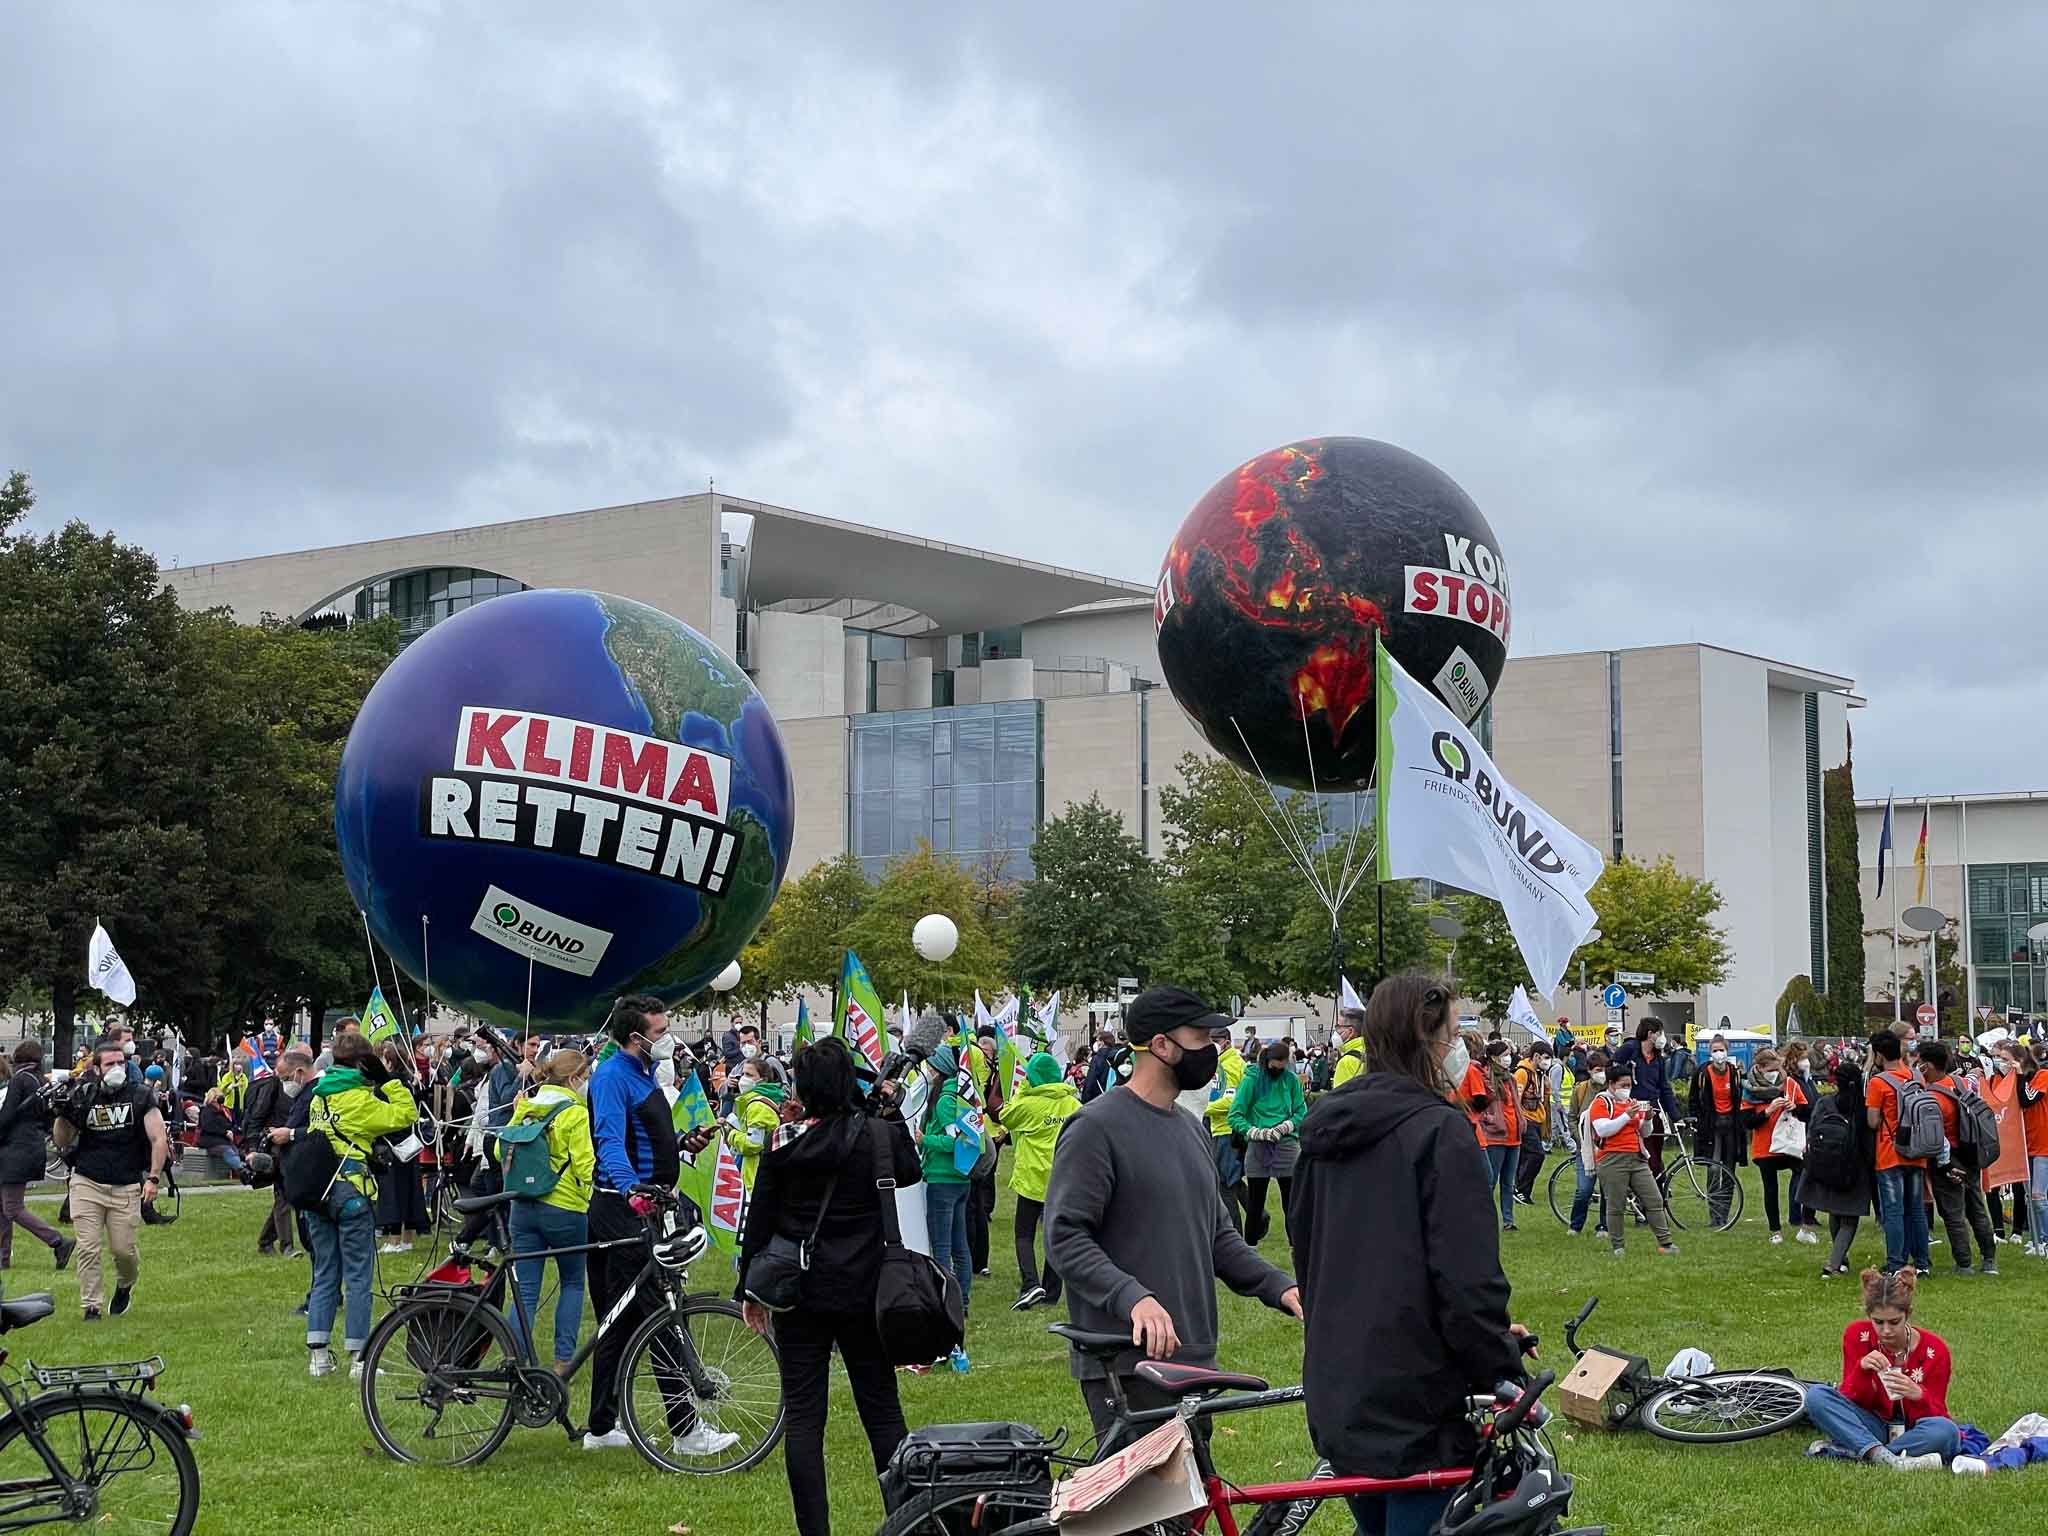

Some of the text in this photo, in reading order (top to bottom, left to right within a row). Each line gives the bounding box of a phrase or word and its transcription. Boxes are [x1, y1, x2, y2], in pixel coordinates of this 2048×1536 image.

[1459, 676, 1480, 708] BUND
[465, 711, 719, 816] KLIMA
[430, 777, 736, 893] RETTEN!
[1424, 778, 1470, 804] FRIENDS
[1508, 859, 1546, 903] GERMANY
[1474, 769, 1565, 874] BUND
[517, 919, 585, 954] BUND
[86, 1104, 130, 1126] AEW
